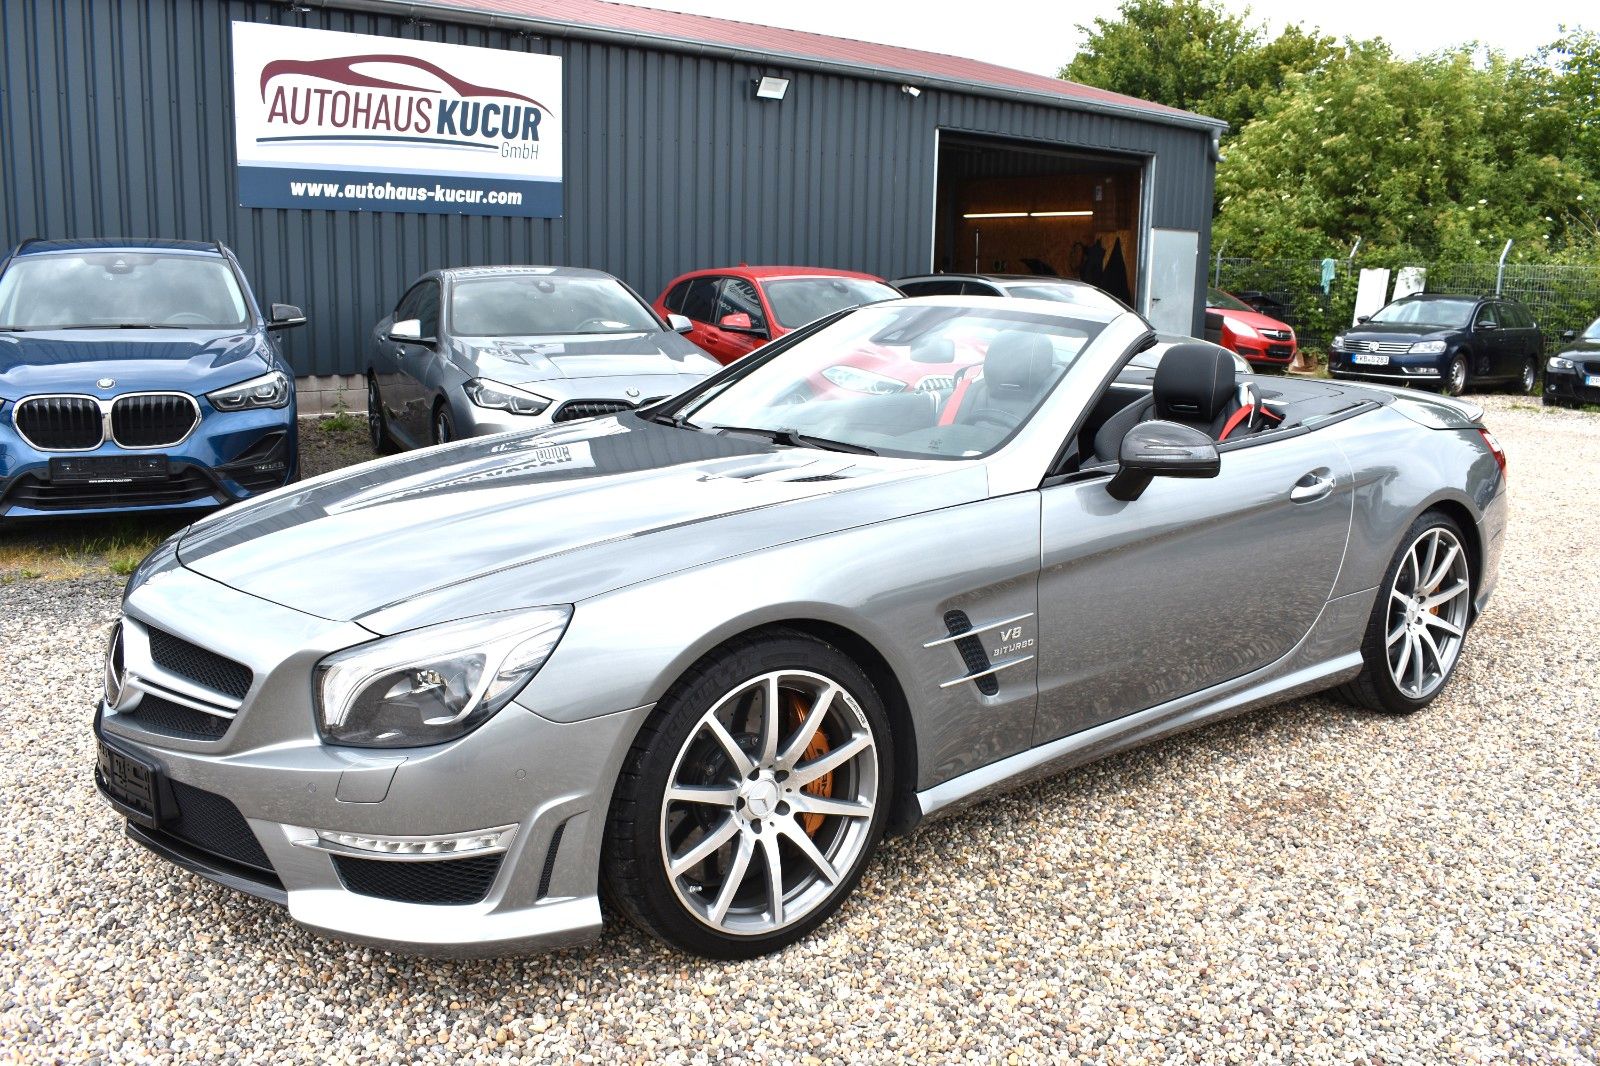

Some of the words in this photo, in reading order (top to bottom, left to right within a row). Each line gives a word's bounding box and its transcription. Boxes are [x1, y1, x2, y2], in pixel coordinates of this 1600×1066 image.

[268, 86, 432, 134] AUTOHAUS
[436, 99, 542, 142] KUCUR
[501, 142, 539, 160] GmbH
[290, 181, 522, 205] www.autohaus-kucur.com
[1000, 626, 1022, 642] V8
[993, 638, 1034, 656] BITURBO
